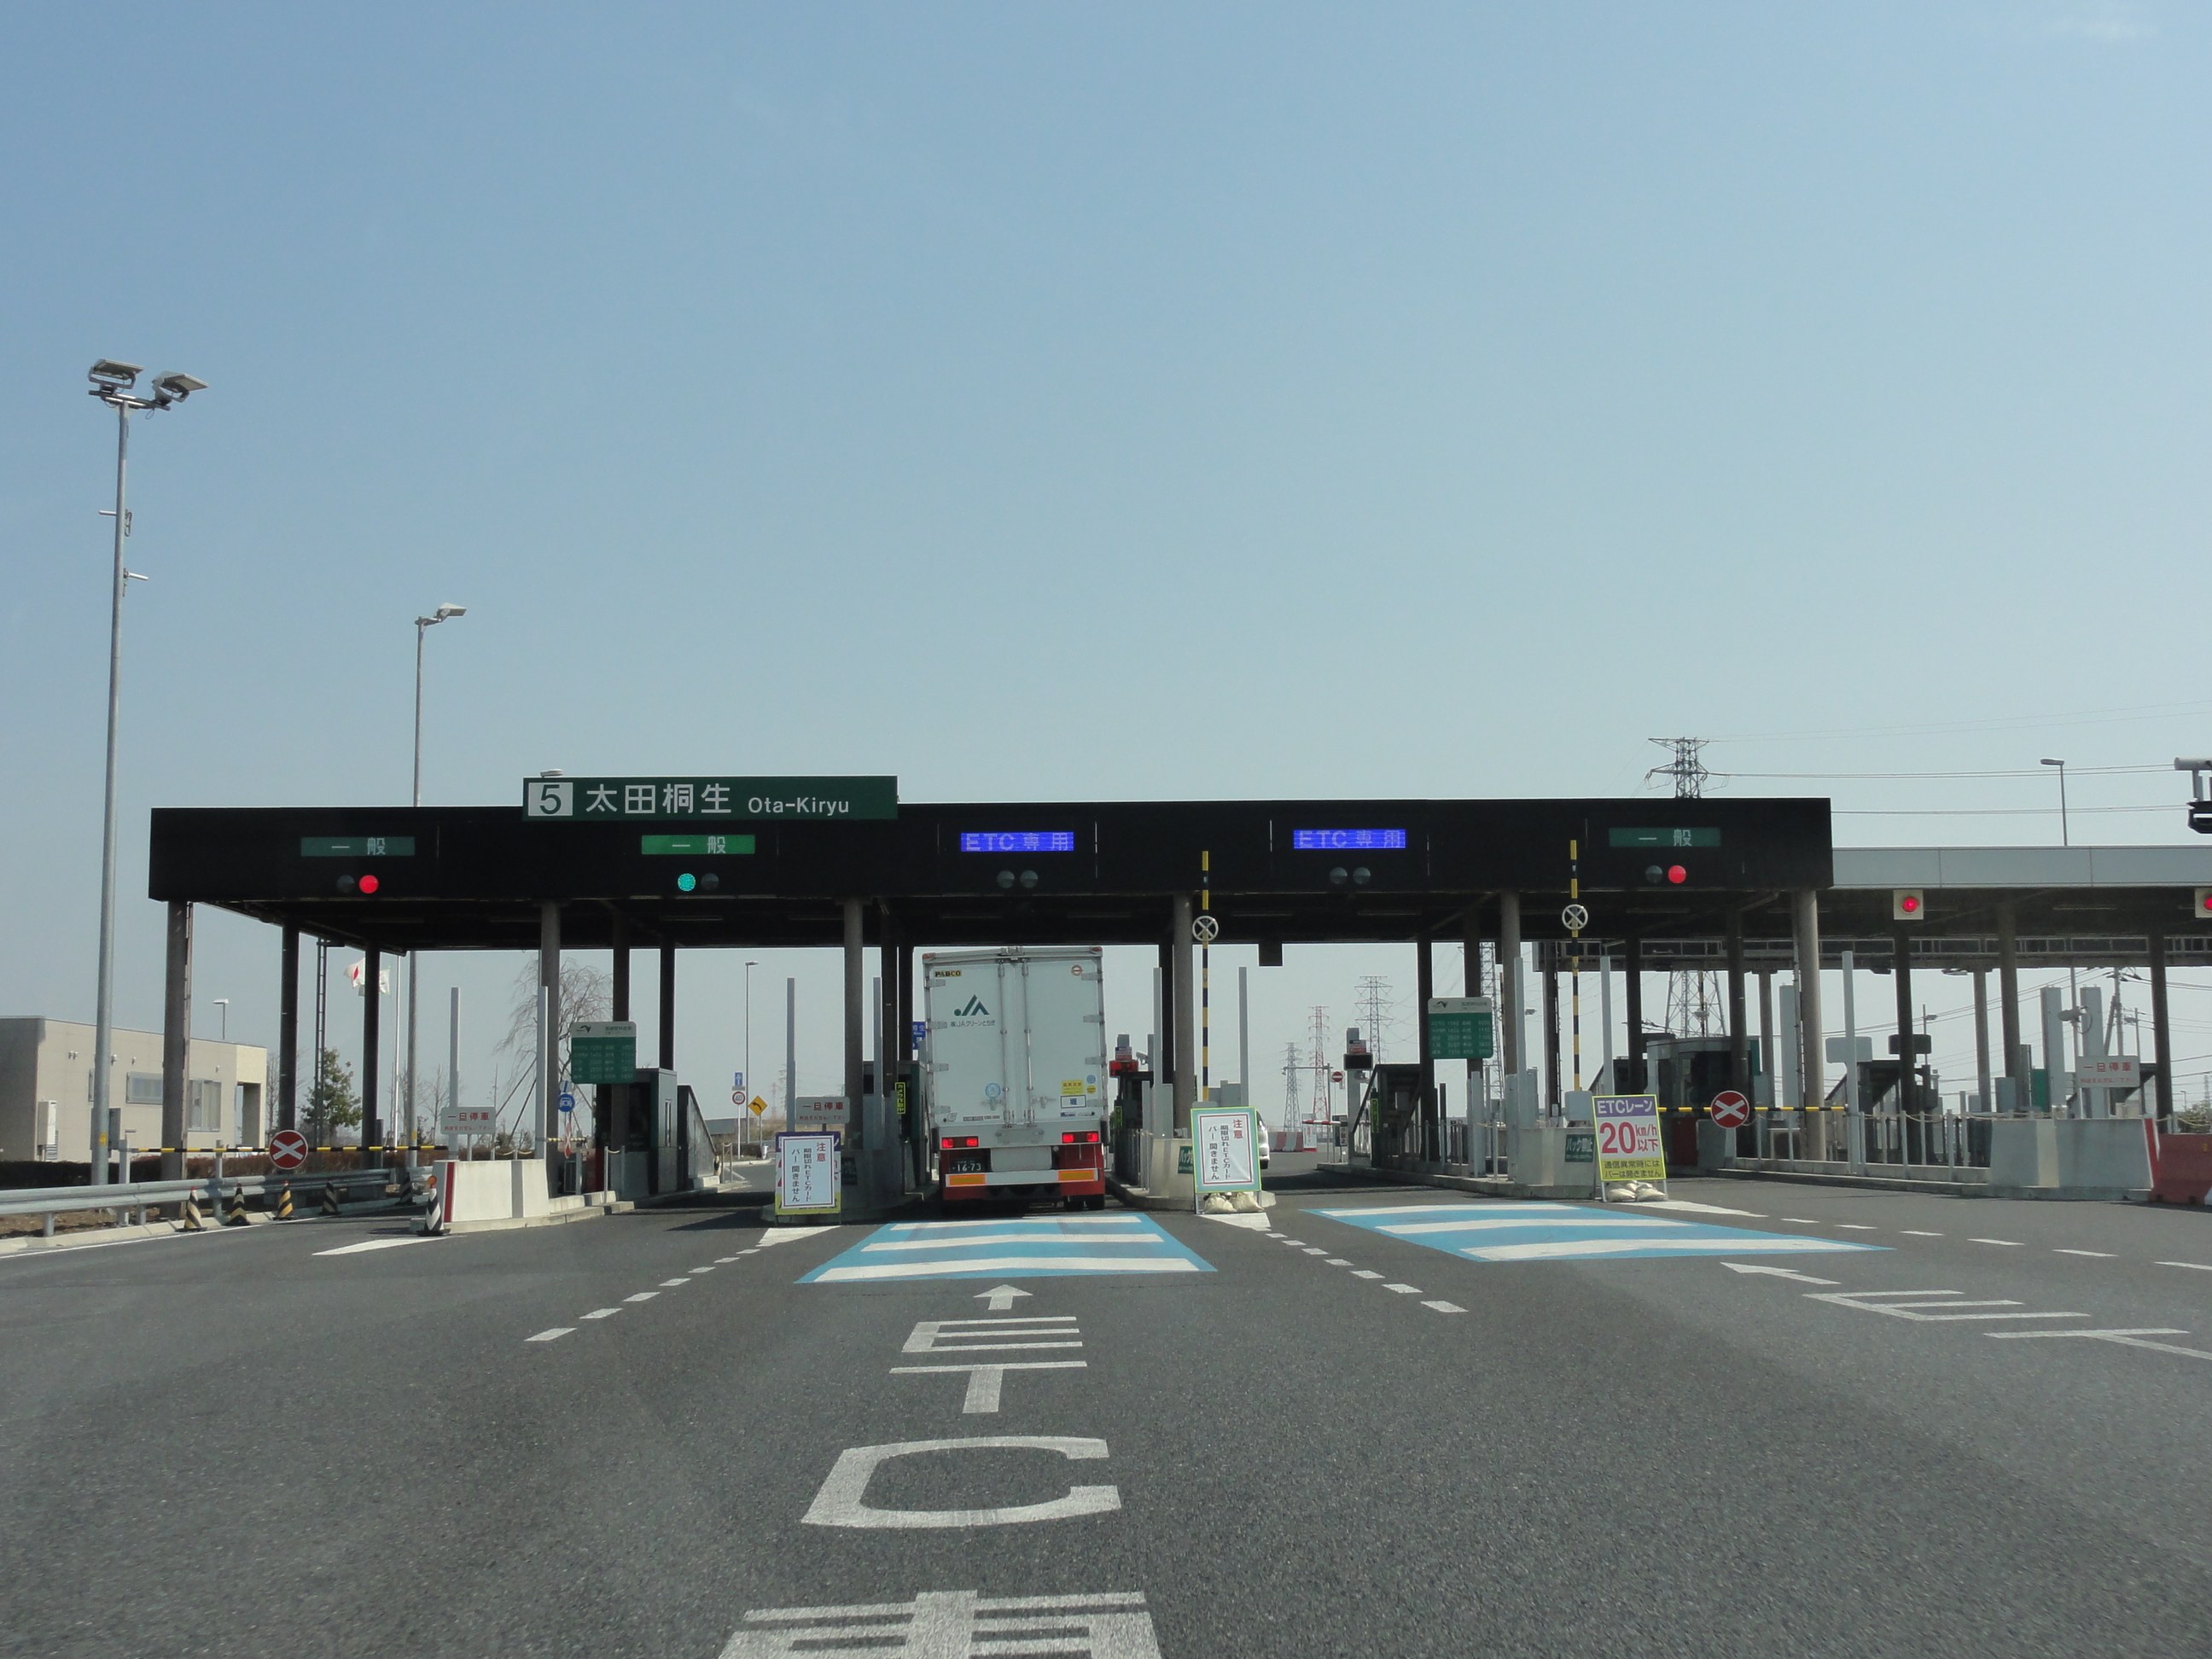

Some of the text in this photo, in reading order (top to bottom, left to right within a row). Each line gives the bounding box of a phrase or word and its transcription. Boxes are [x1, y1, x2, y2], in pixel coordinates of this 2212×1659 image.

[538, 783, 850, 817] 5 太田桐生 Ota-Kiryu
[330, 837, 387, 856] 一般
[671, 835, 726, 854] 一般
[1638, 828, 1692, 847] 一般
[1597, 1099, 1653, 1115] ETCレーン
[1232, 1119, 1243, 1139] 注意
[1599, 1121, 1657, 1154] 20 km/h
[816, 1142, 826, 1162] 注意
[1637, 1138, 1659, 1152] 以下
